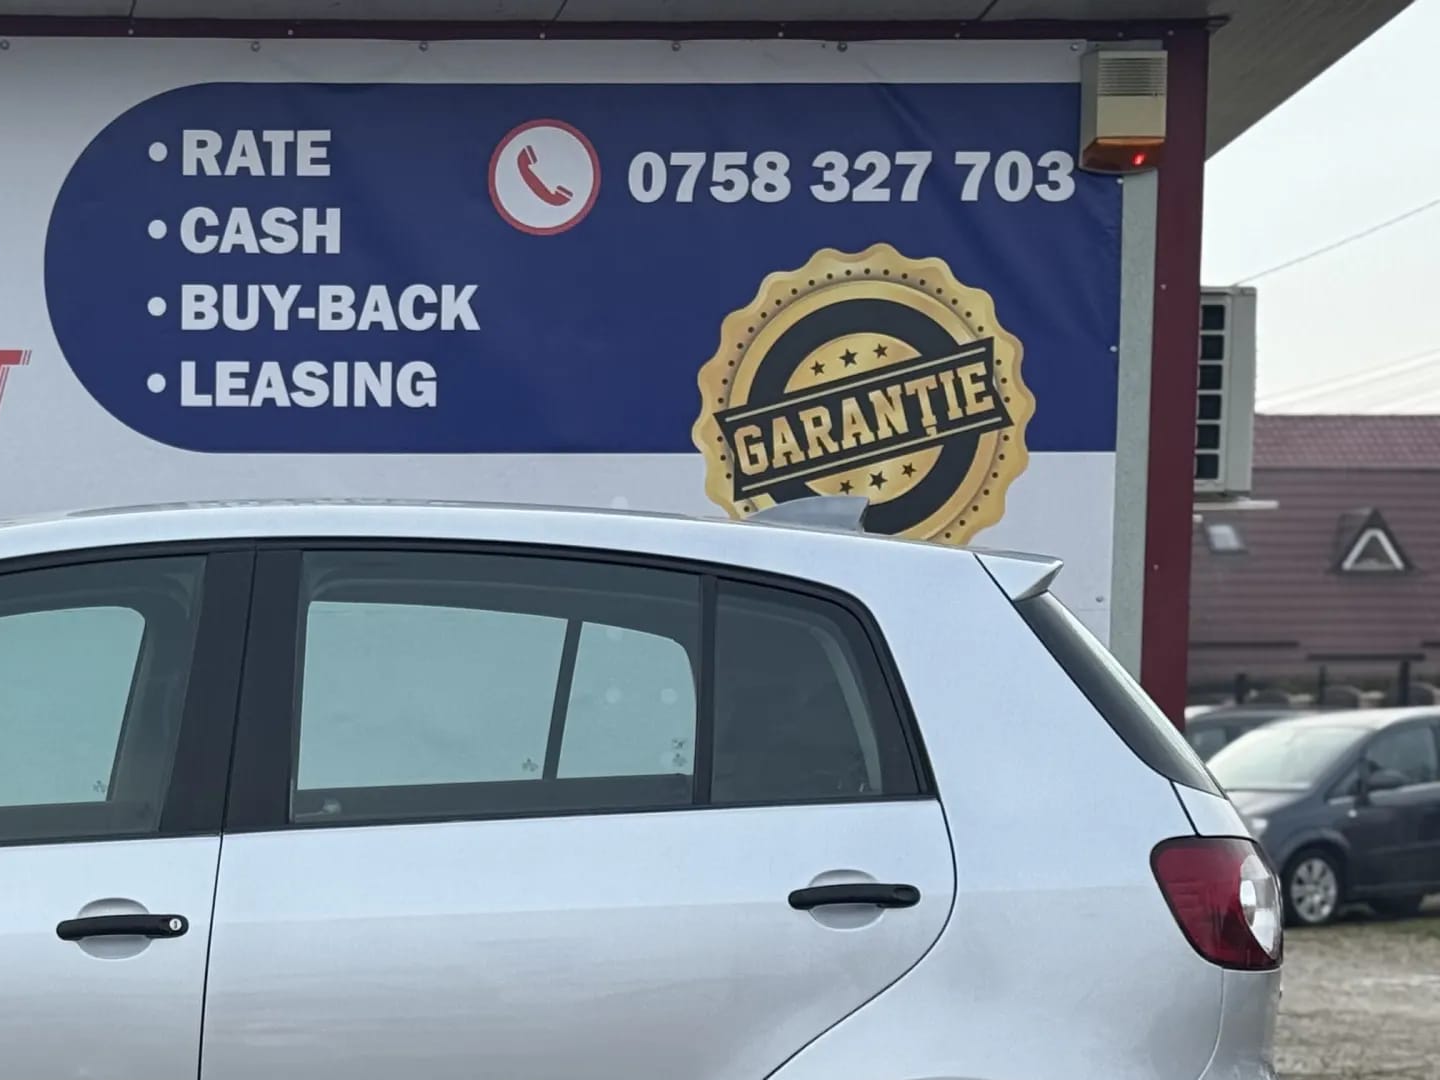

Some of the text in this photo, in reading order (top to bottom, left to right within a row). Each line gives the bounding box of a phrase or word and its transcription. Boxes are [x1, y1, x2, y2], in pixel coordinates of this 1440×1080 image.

[182, 129, 331, 176] RATE
[628, 150, 1076, 202] 0758 327 703
[180, 206, 341, 254] CASH
[181, 284, 480, 331] BUY-BACK
[180, 360, 438, 408] LEASING
